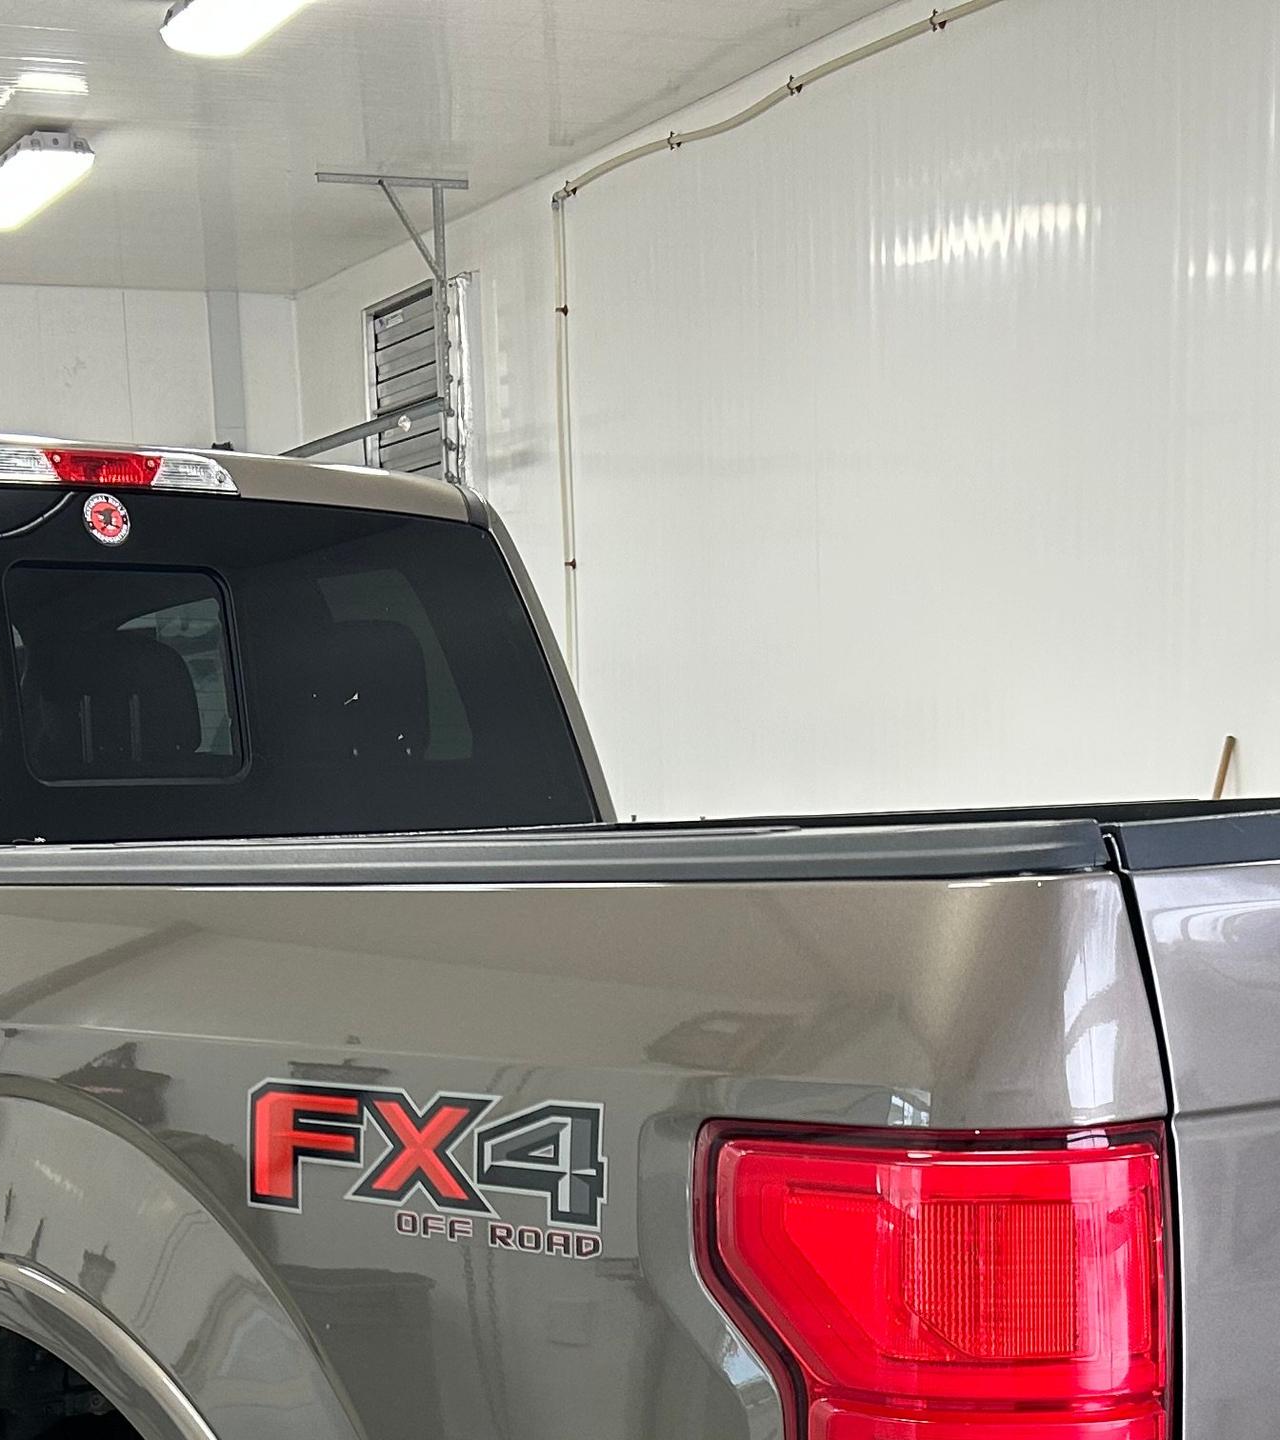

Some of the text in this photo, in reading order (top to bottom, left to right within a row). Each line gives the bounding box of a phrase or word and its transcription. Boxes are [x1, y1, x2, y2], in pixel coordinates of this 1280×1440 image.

[248, 1077, 608, 1231] FX4
[395, 1210, 603, 1260] OFF ROAD
